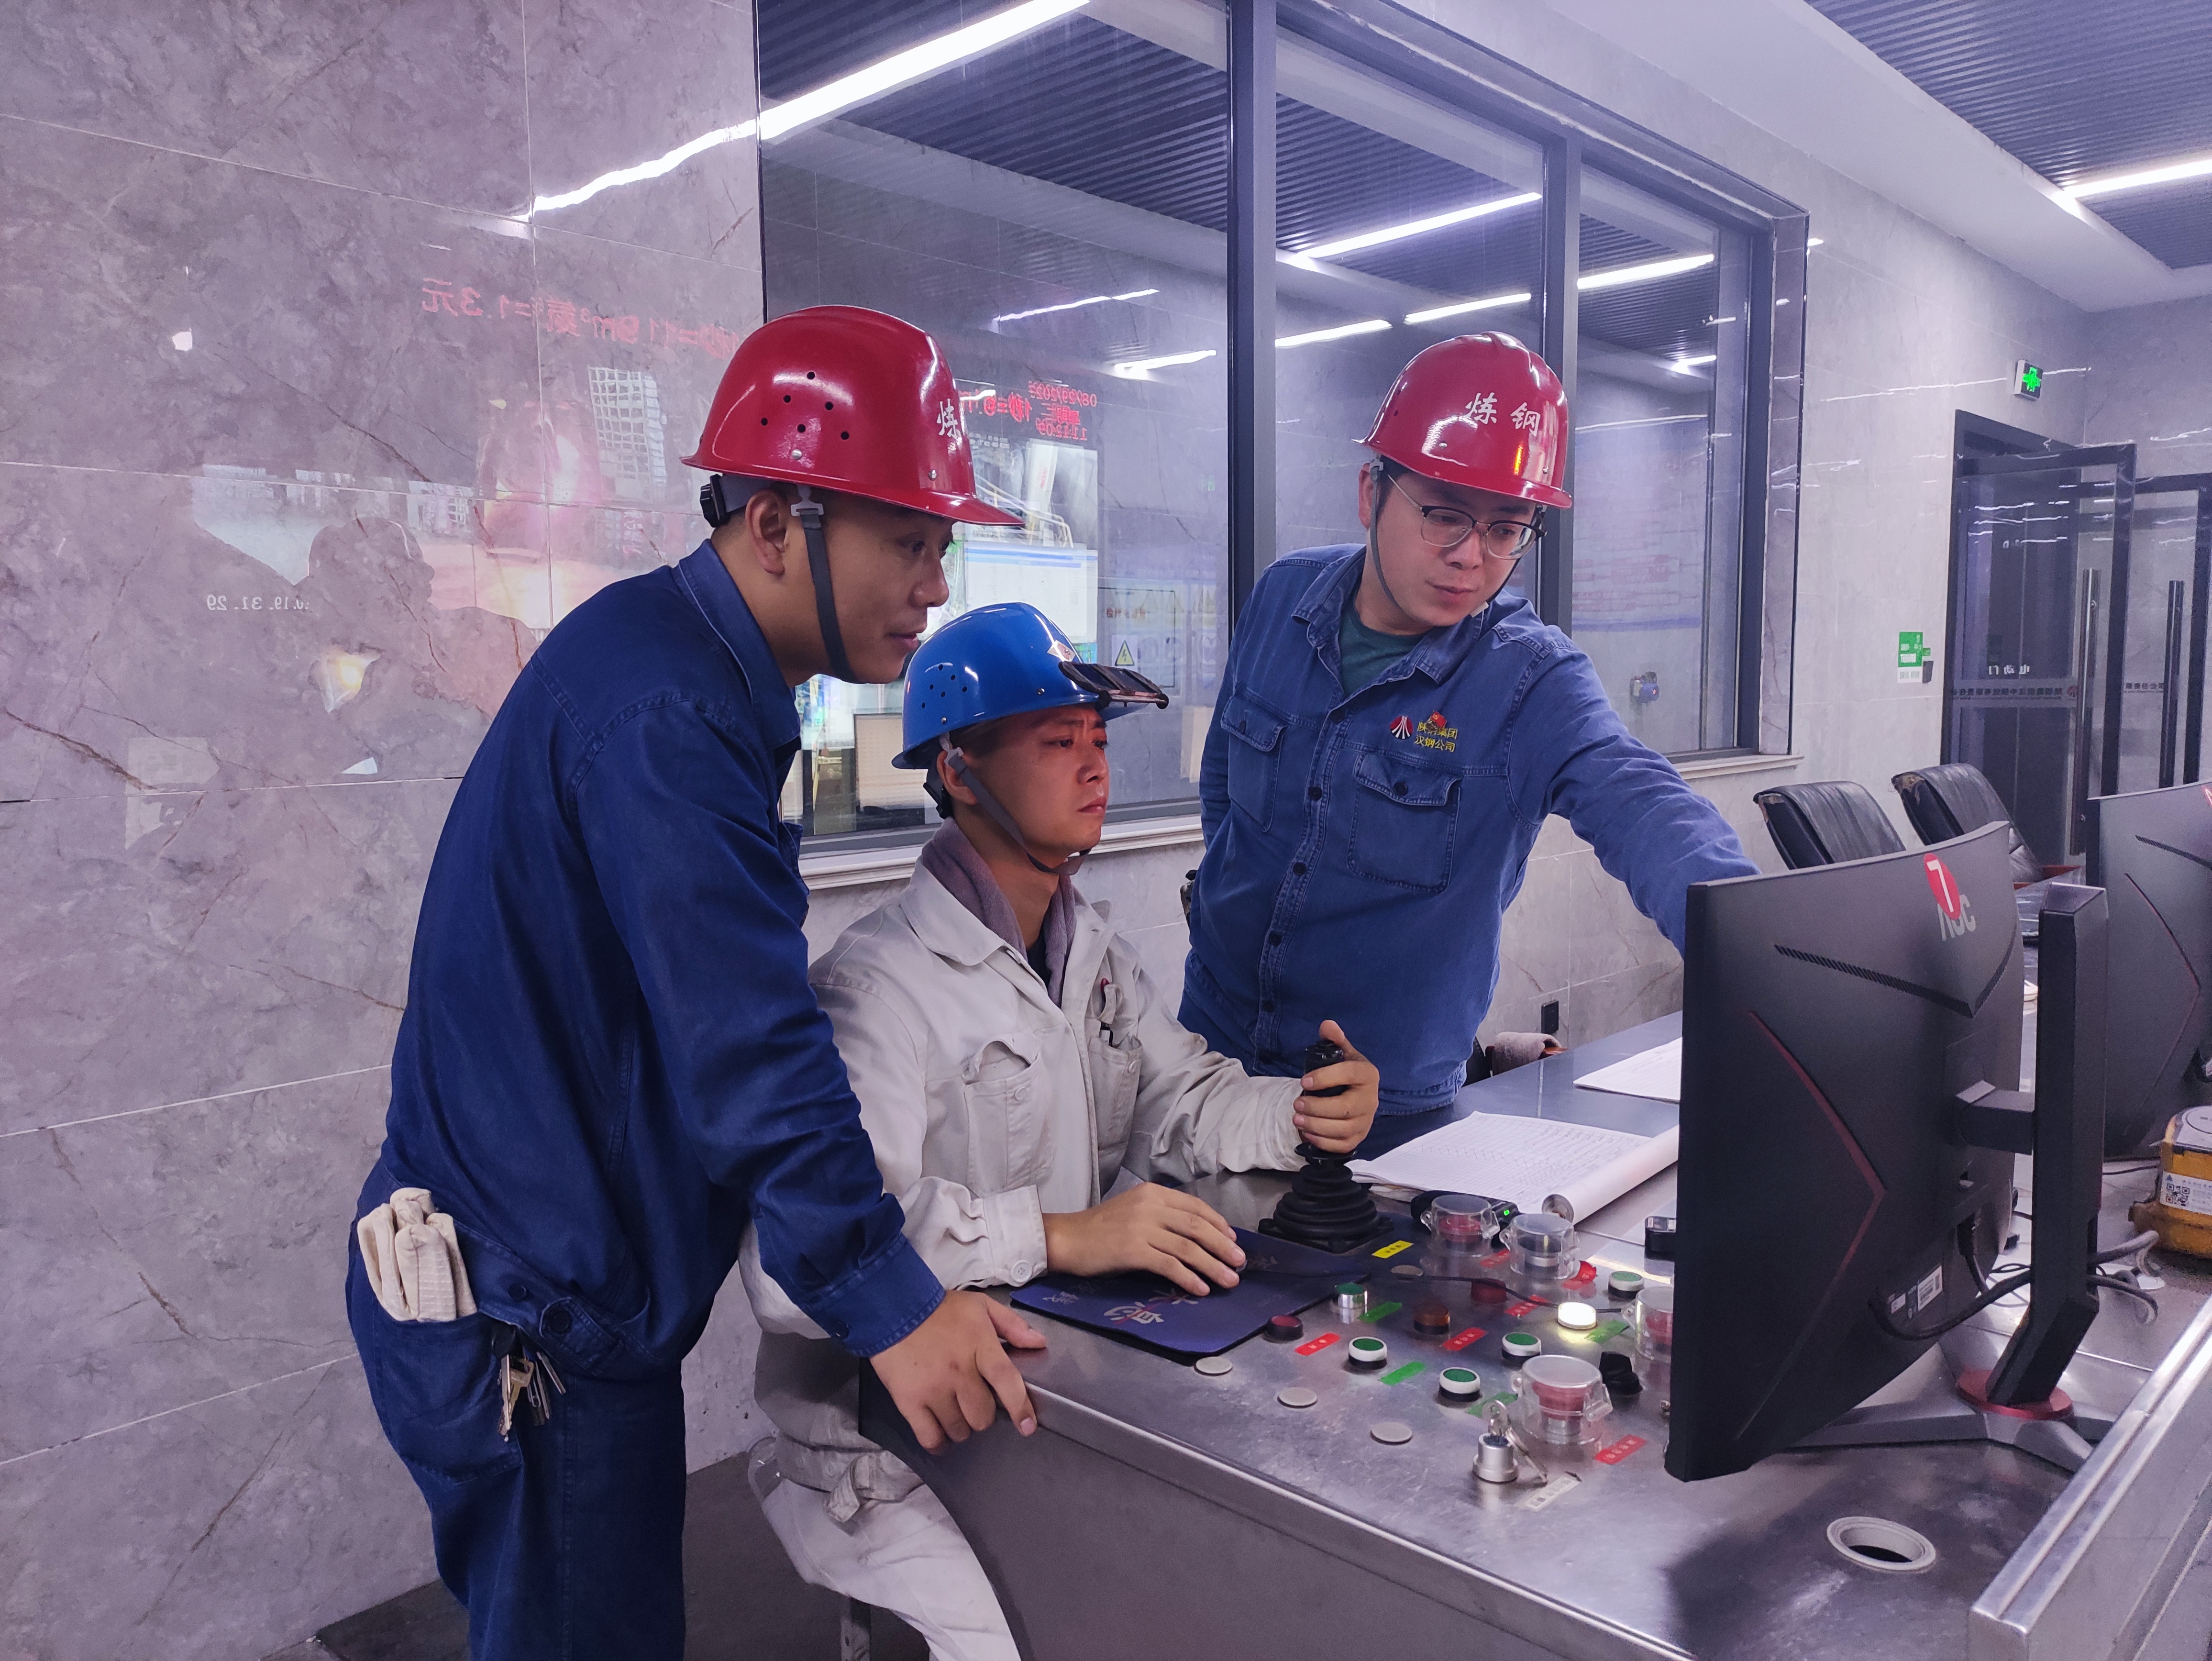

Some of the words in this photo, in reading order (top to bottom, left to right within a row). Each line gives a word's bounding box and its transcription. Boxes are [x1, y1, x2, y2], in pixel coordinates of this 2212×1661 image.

[936, 398, 959, 440] 炼
[1465, 392, 1541, 437] 炼钢
[1414, 735, 1456, 753] 汉钢公司
